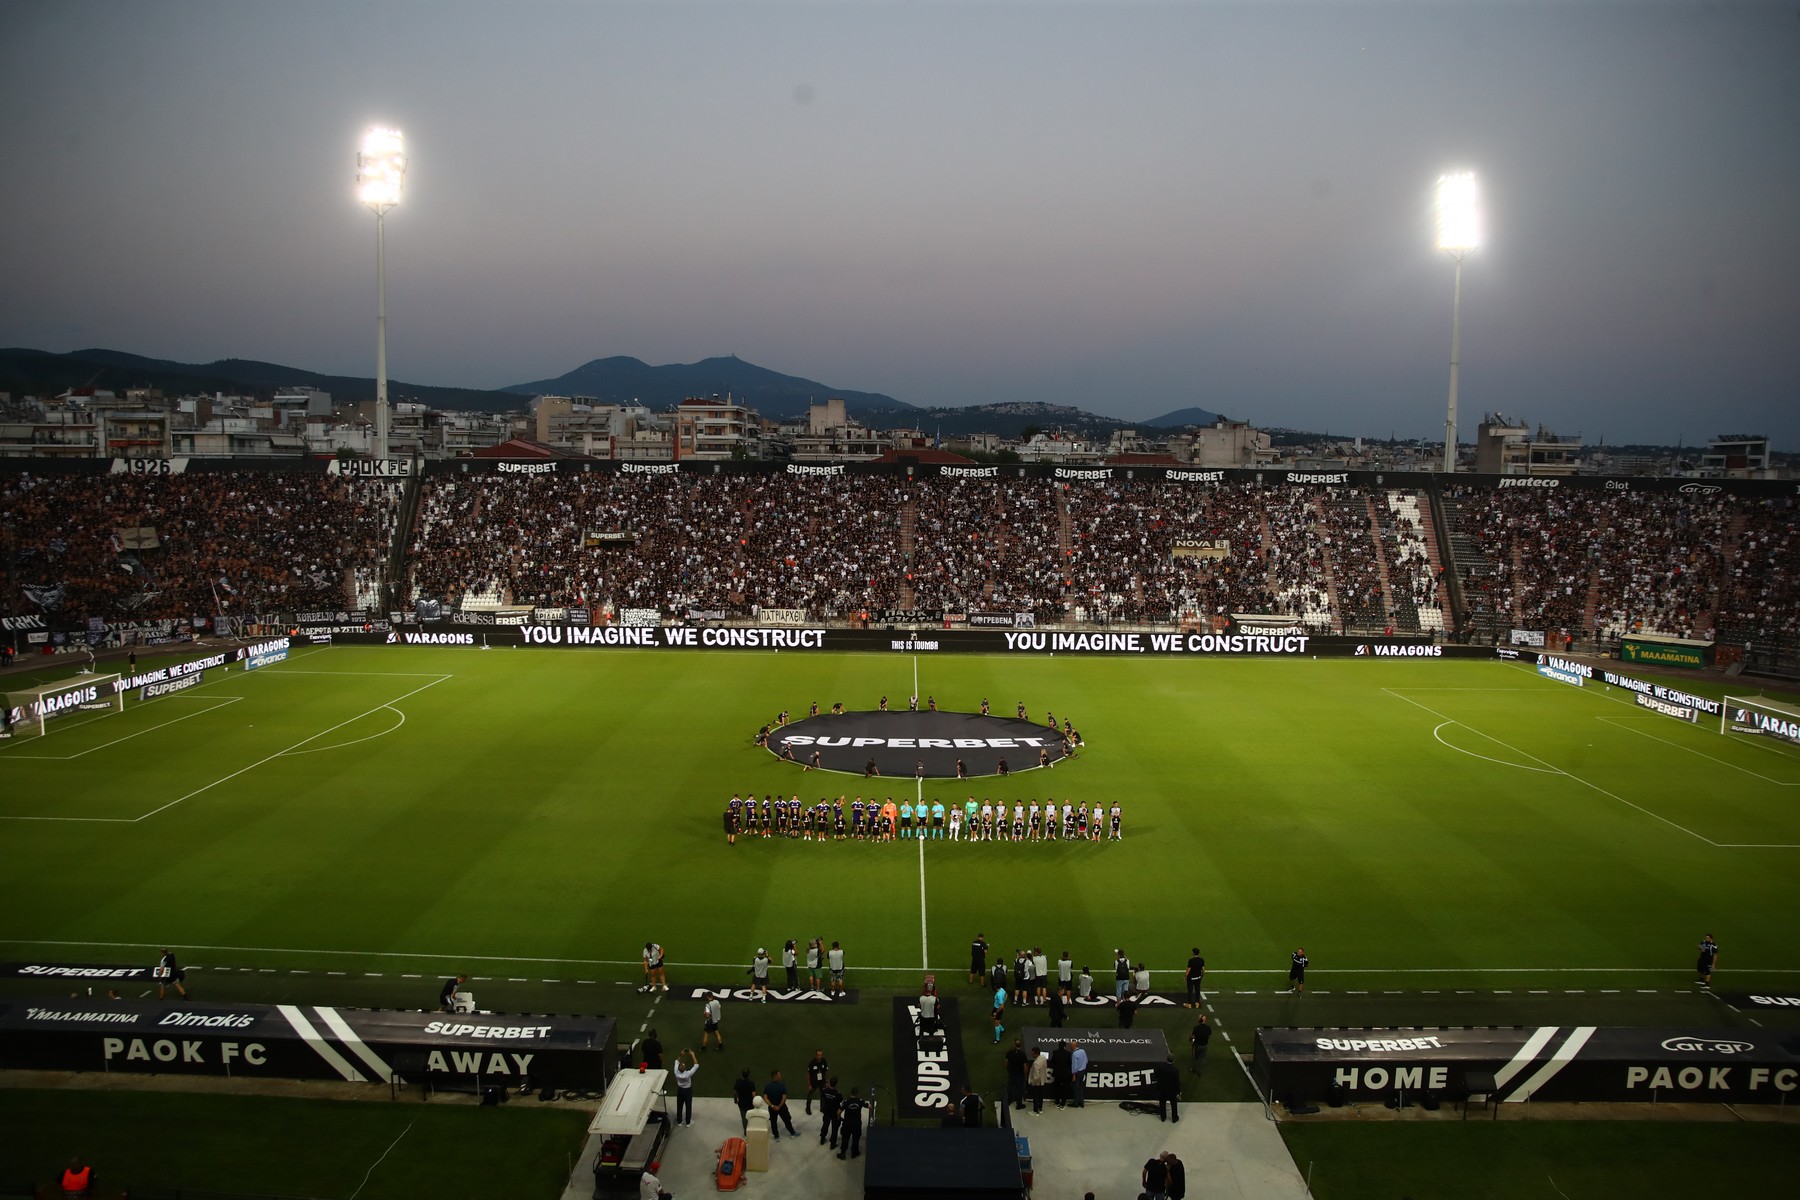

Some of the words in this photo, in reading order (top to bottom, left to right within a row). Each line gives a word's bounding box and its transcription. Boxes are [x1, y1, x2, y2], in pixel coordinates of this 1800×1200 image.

[124, 458, 170, 474] 1926
[338, 459, 383, 477] PAOK
[388, 460, 407, 474] FC
[498, 462, 557, 473] SUPERBET
[621, 462, 680, 474] SUPERBET
[786, 464, 845, 476] SUPERBET
[940, 465, 998, 478] SUPERBET
[1054, 467, 1113, 480] SUPERBET
[1165, 469, 1224, 482] SUPERBET
[1287, 472, 1348, 484] SUPERBET
[1499, 477, 1559, 489] mateco
[405, 633, 473, 644] VARAGONS
[520, 626, 561, 643] YOU
[567, 627, 659, 647] IMAGINE,
[665, 628, 698, 645] WE
[703, 629, 826, 647] CONSTRUCT
[1004, 633, 1046, 650] YOU
[1052, 633, 1145, 653] IMAGINE,
[1151, 635, 1183, 651] WE
[1188, 636, 1309, 652] CONSTRUCT
[248, 638, 290, 657] VARAGONS
[891, 640, 905, 650] THIS
[906, 641, 912, 650] IS
[914, 641, 938, 650] TOUMBA
[1374, 645, 1442, 656] VARAGONS
[113, 678, 131, 693] YOU
[132, 669, 169, 688] IMAGINE,
[169, 665, 182, 678] WE
[183, 653, 226, 674] CONSTRUCT
[1549, 656, 1592, 678] VARAGONS
[147, 673, 202, 697] SUPERBET
[1604, 671, 1618, 685] YOU
[1619, 675, 1653, 695] IMAGINE,
[1654, 685, 1667, 699] WE
[1668, 689, 1720, 714] CONSTRUCT
[1637, 693, 1692, 718] SUPERBET
[781, 735, 1044, 748] SUPERBET
[18, 965, 146, 977] SUPERBET
[691, 988, 833, 1000] NOVA
[158, 1012, 255, 1028] Dimakis
[424, 1021, 551, 1039] SUPERBET
[1316, 1035, 1442, 1051] SUPERBET
[103, 1037, 205, 1063] PAOK
[221, 1042, 267, 1066] FC
[427, 1050, 534, 1075] AWAY
[1336, 1066, 1448, 1090] HOME
[1627, 1067, 1732, 1090] PAOK
[1750, 1068, 1799, 1092] FC
